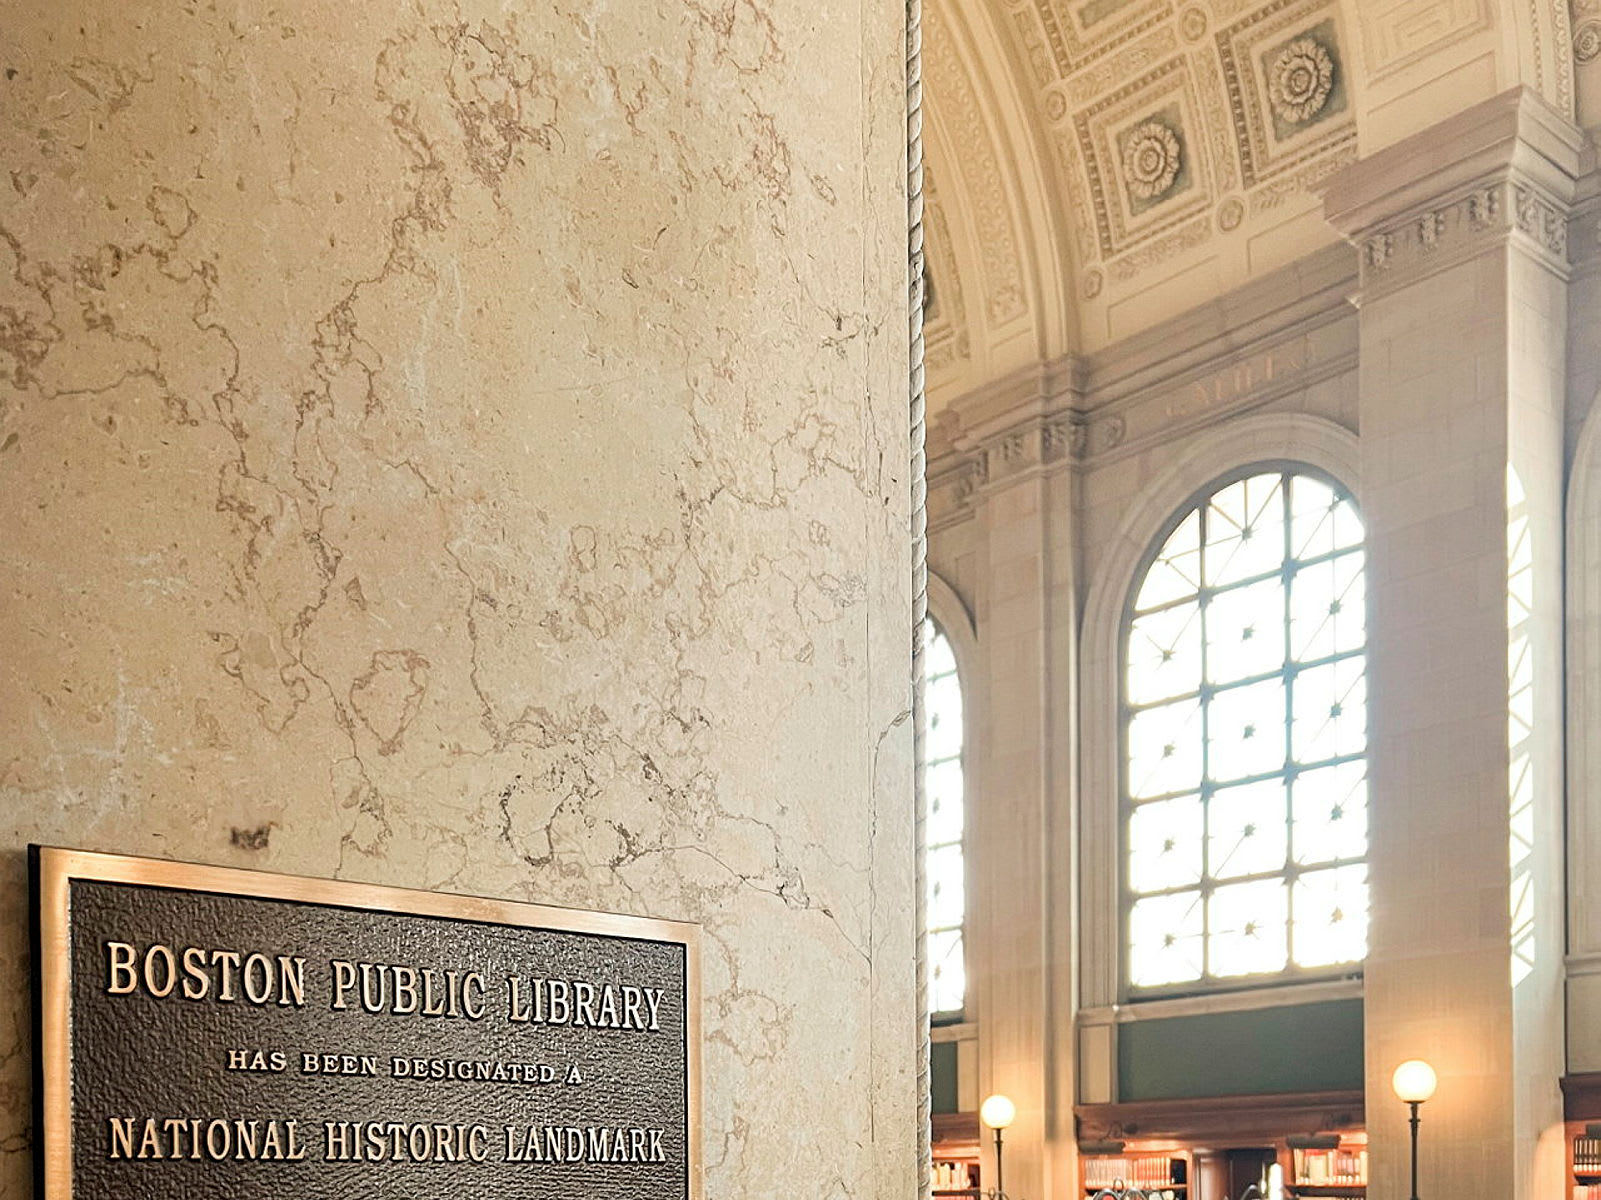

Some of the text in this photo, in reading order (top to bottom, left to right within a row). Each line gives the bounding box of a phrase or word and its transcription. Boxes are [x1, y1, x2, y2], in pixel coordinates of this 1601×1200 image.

[107, 941, 664, 1031] BOSTON PUBLIC LIBRARY
[229, 1050, 583, 1084] HAS BEEN DESIGNATED A
[109, 1117, 666, 1162] NATIONAL HISTORIC LANDMARK
